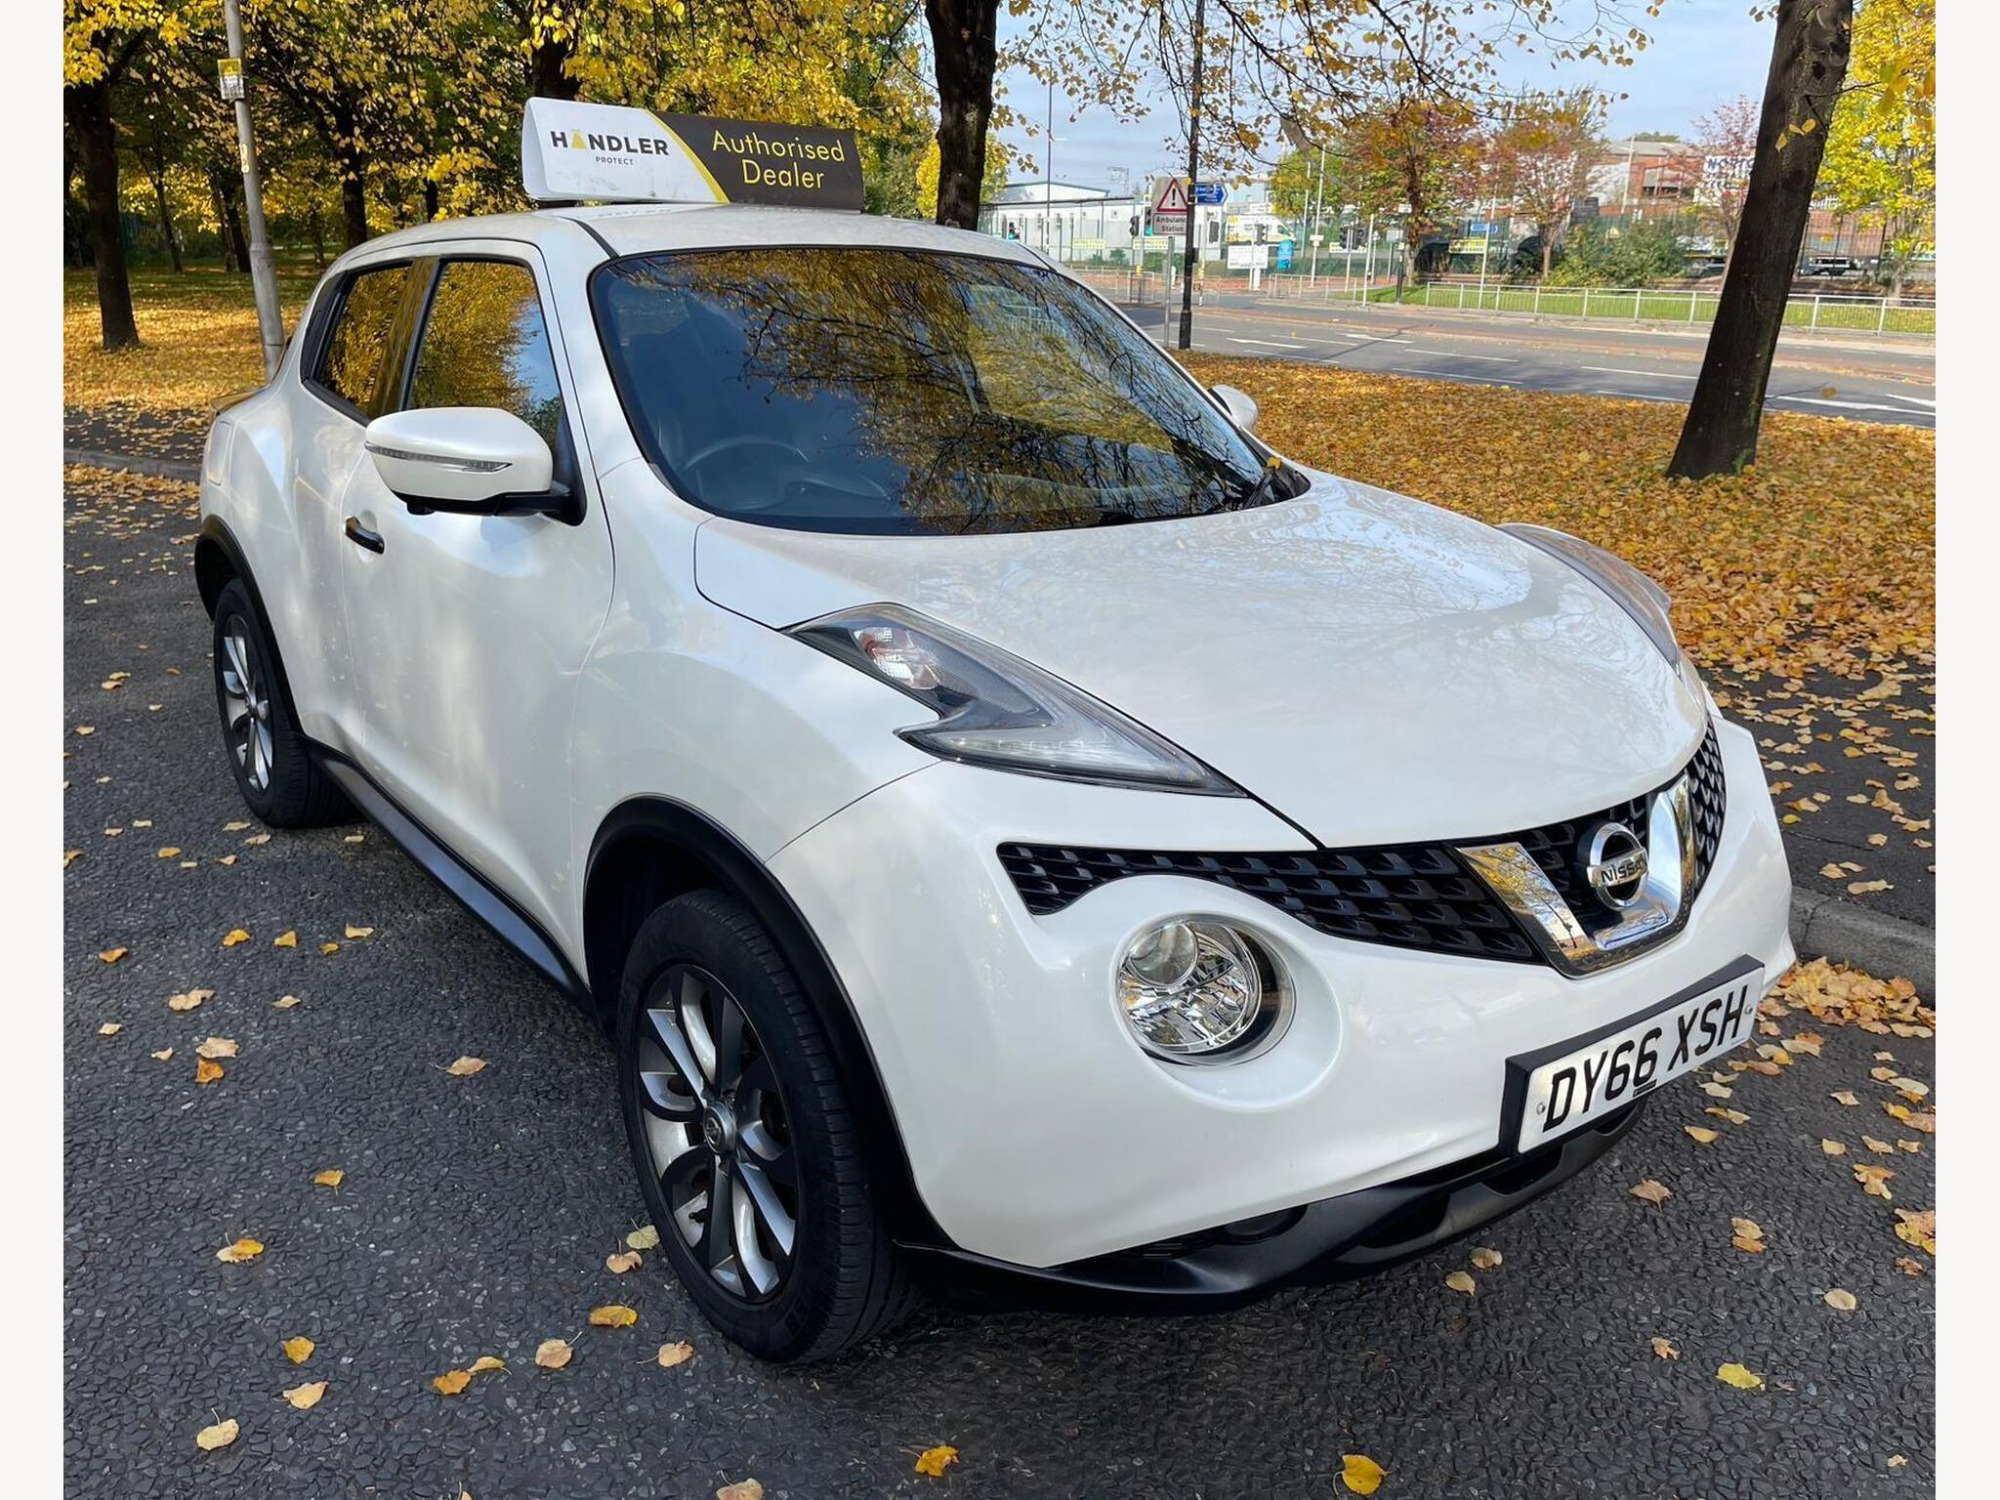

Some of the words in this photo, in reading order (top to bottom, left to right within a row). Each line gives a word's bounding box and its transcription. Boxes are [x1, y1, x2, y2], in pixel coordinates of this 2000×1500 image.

[550, 128, 669, 156] HANDLER
[712, 129, 845, 162] Authorised
[595, 156, 634, 165] PROTECT
[741, 159, 825, 189] Dealer
[1156, 215, 1187, 224] Ambulanc
[1161, 225, 1184, 233] Station
[1542, 1027, 1663, 1133] DY66
[1667, 985, 1748, 1072] XSH
